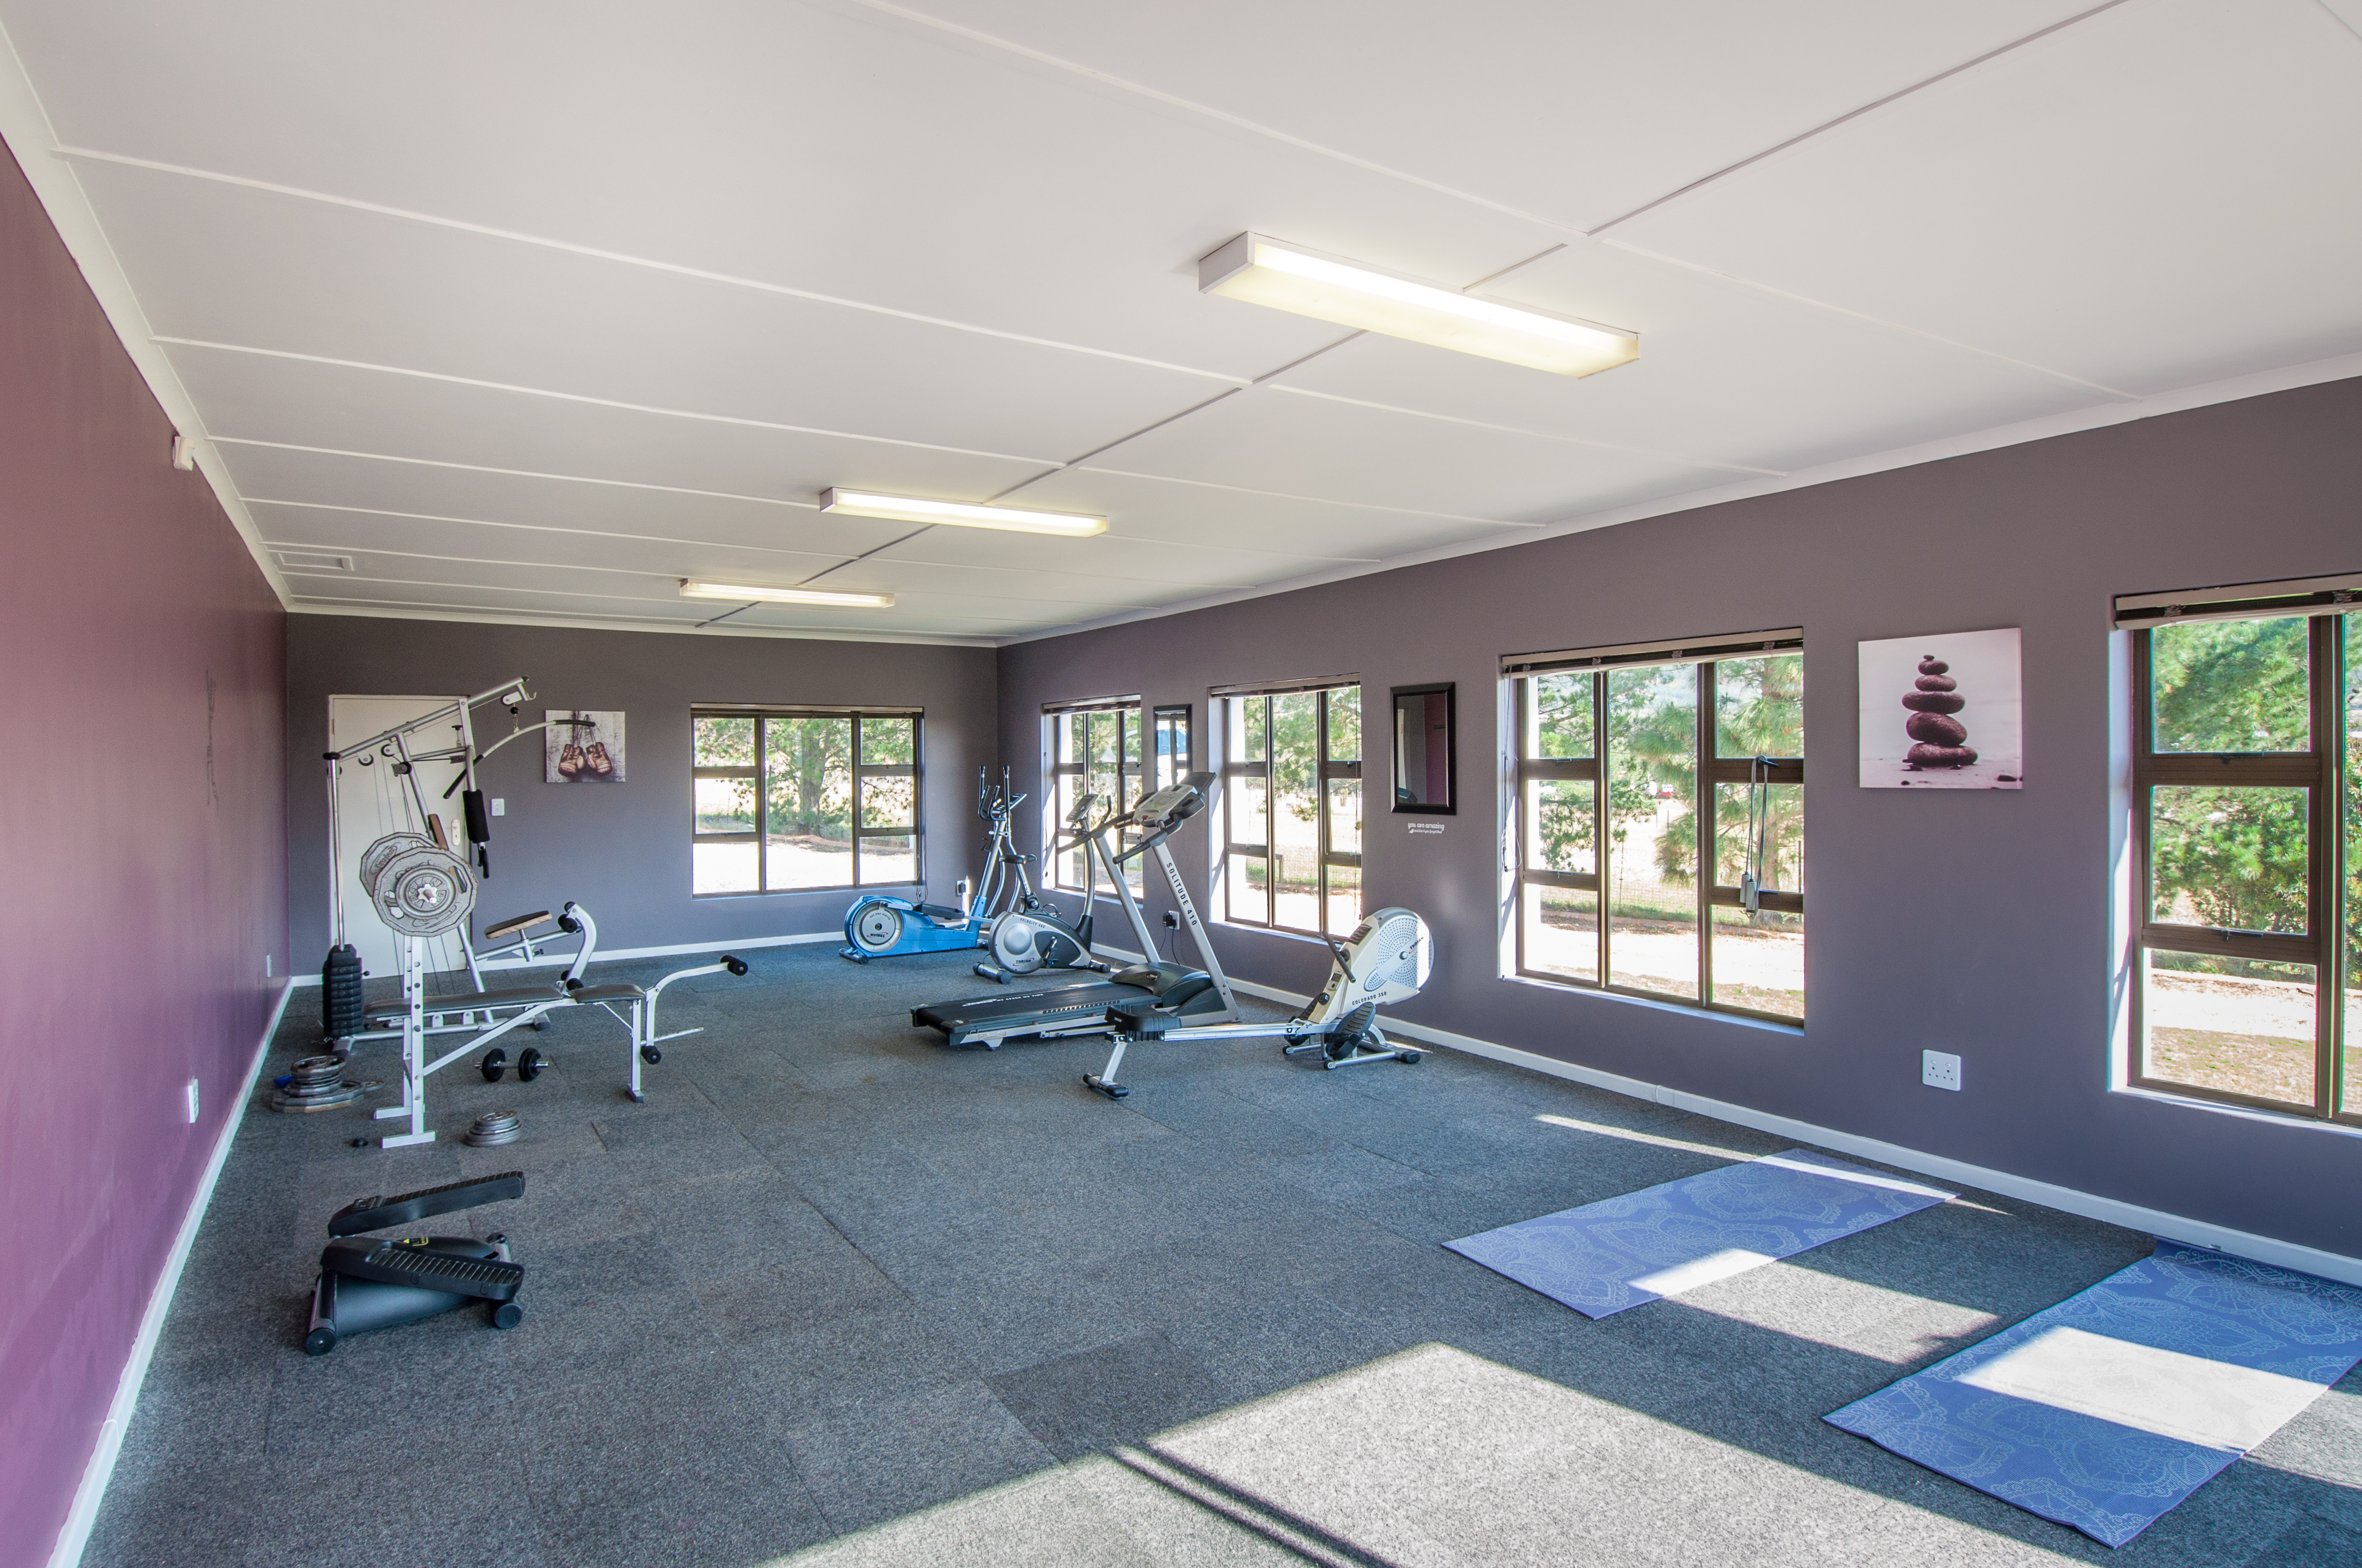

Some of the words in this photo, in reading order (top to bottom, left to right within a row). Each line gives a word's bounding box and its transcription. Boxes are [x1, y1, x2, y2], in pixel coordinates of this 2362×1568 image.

[1425, 822, 1445, 831] amazing
[1166, 862, 1189, 906] SOLITUDE
[1187, 909, 1197, 926] 410
[1020, 918, 1037, 926] VELOCITY
[1352, 994, 1377, 1006] COLORADO
